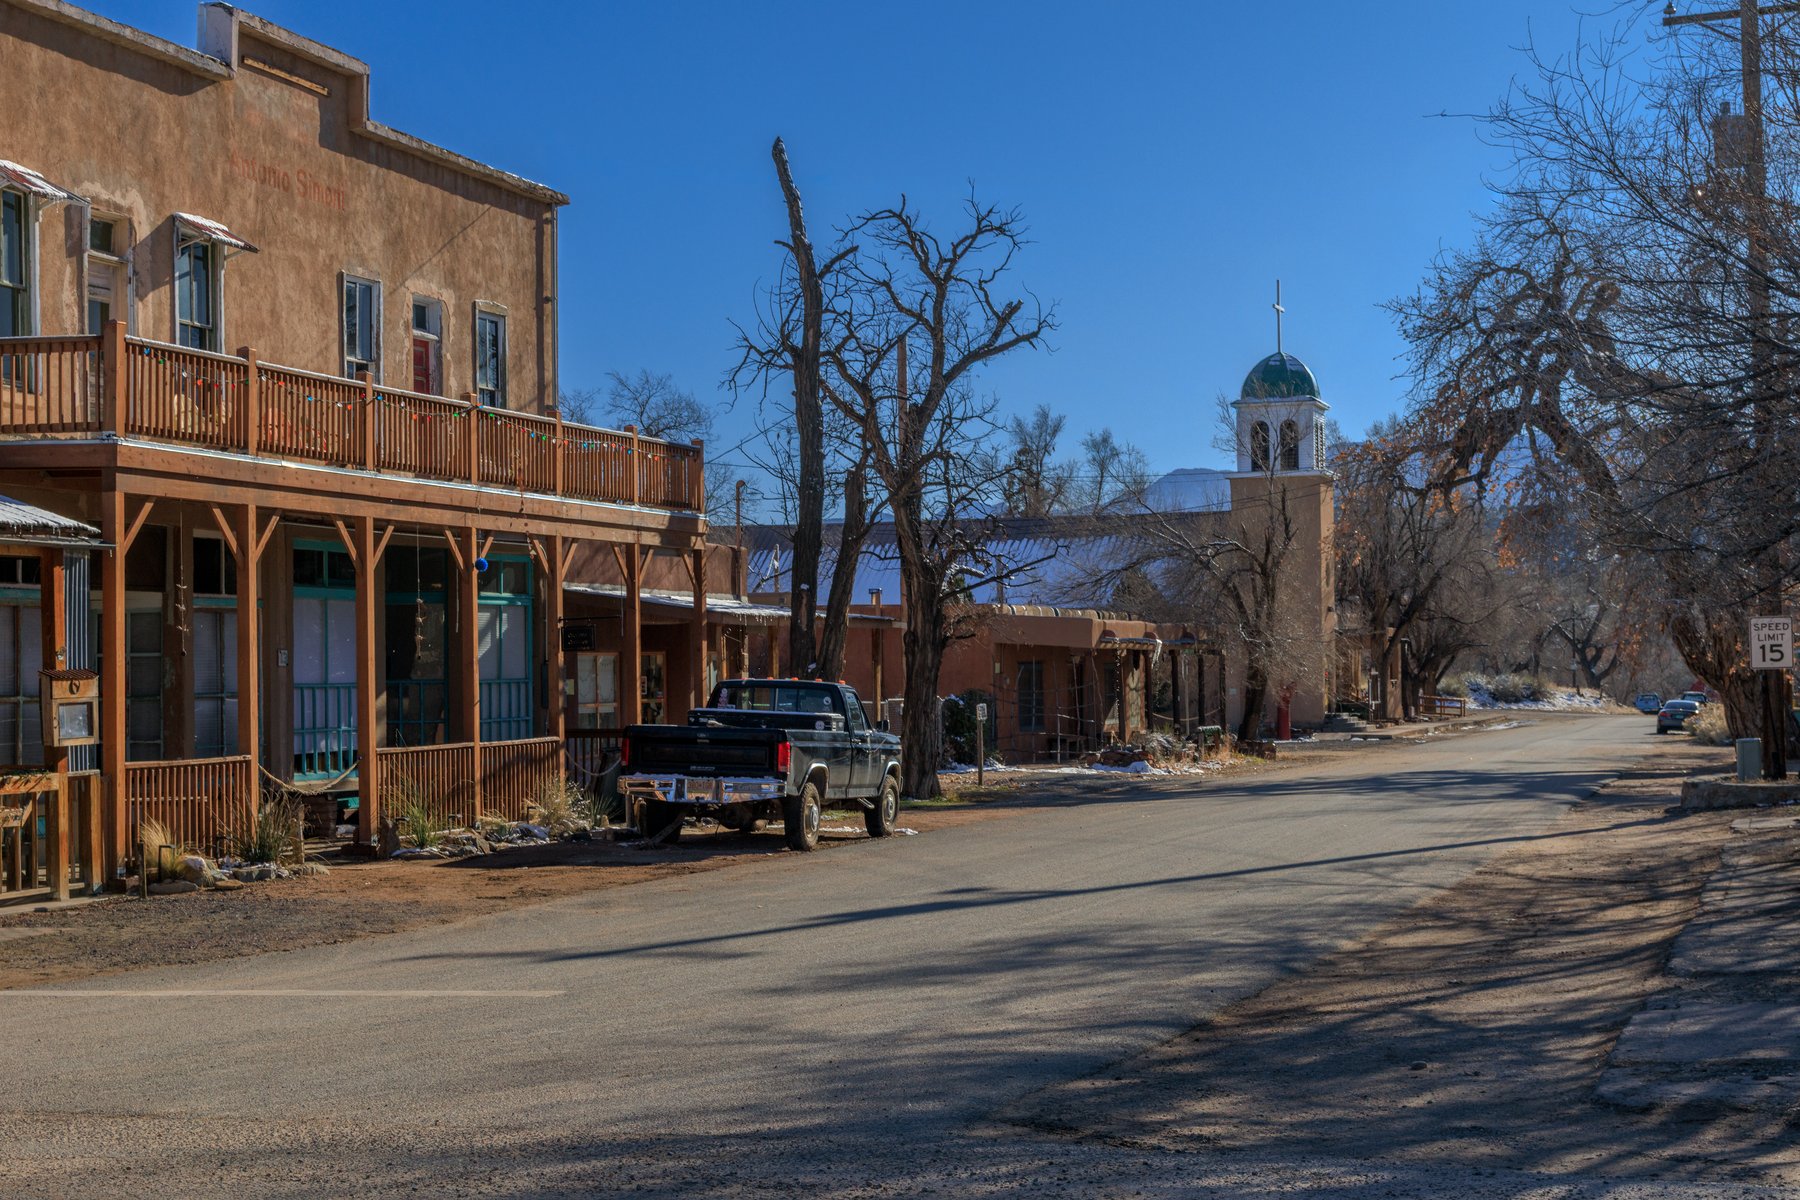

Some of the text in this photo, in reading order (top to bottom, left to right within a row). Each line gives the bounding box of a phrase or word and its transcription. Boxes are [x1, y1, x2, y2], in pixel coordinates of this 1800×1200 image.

[1753, 622, 1790, 631] SPEED
[1758, 633, 1785, 642] LIMIT
[1759, 644, 1784, 662] 15
